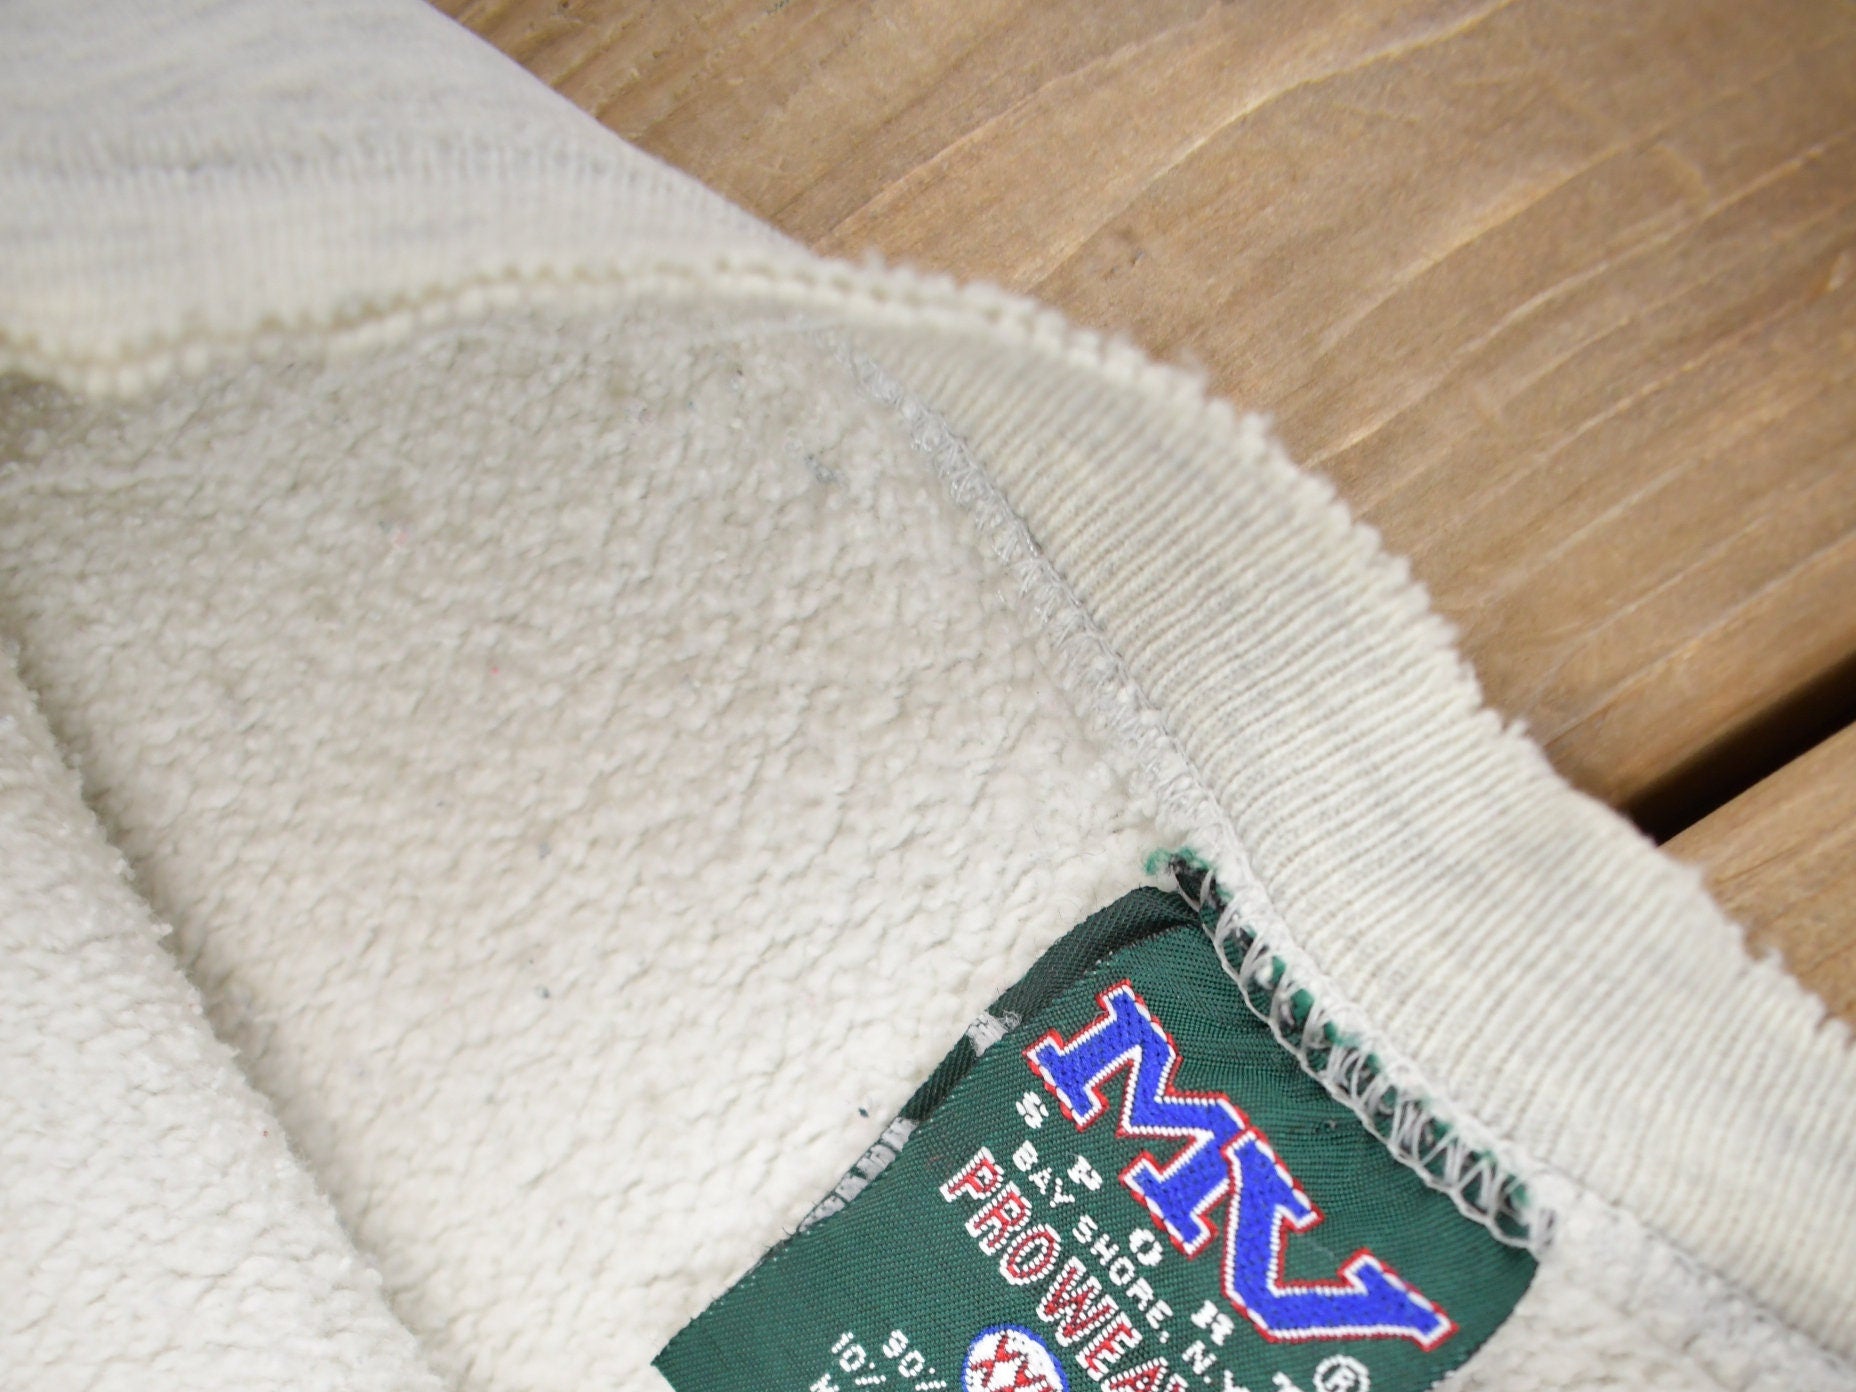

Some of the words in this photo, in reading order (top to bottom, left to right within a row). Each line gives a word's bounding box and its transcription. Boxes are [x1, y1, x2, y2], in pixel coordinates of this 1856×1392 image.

[1012, 1139, 1075, 1209] BAY
[1072, 1214, 1173, 1344] SHORE,
[1023, 979, 1460, 1352] MV
